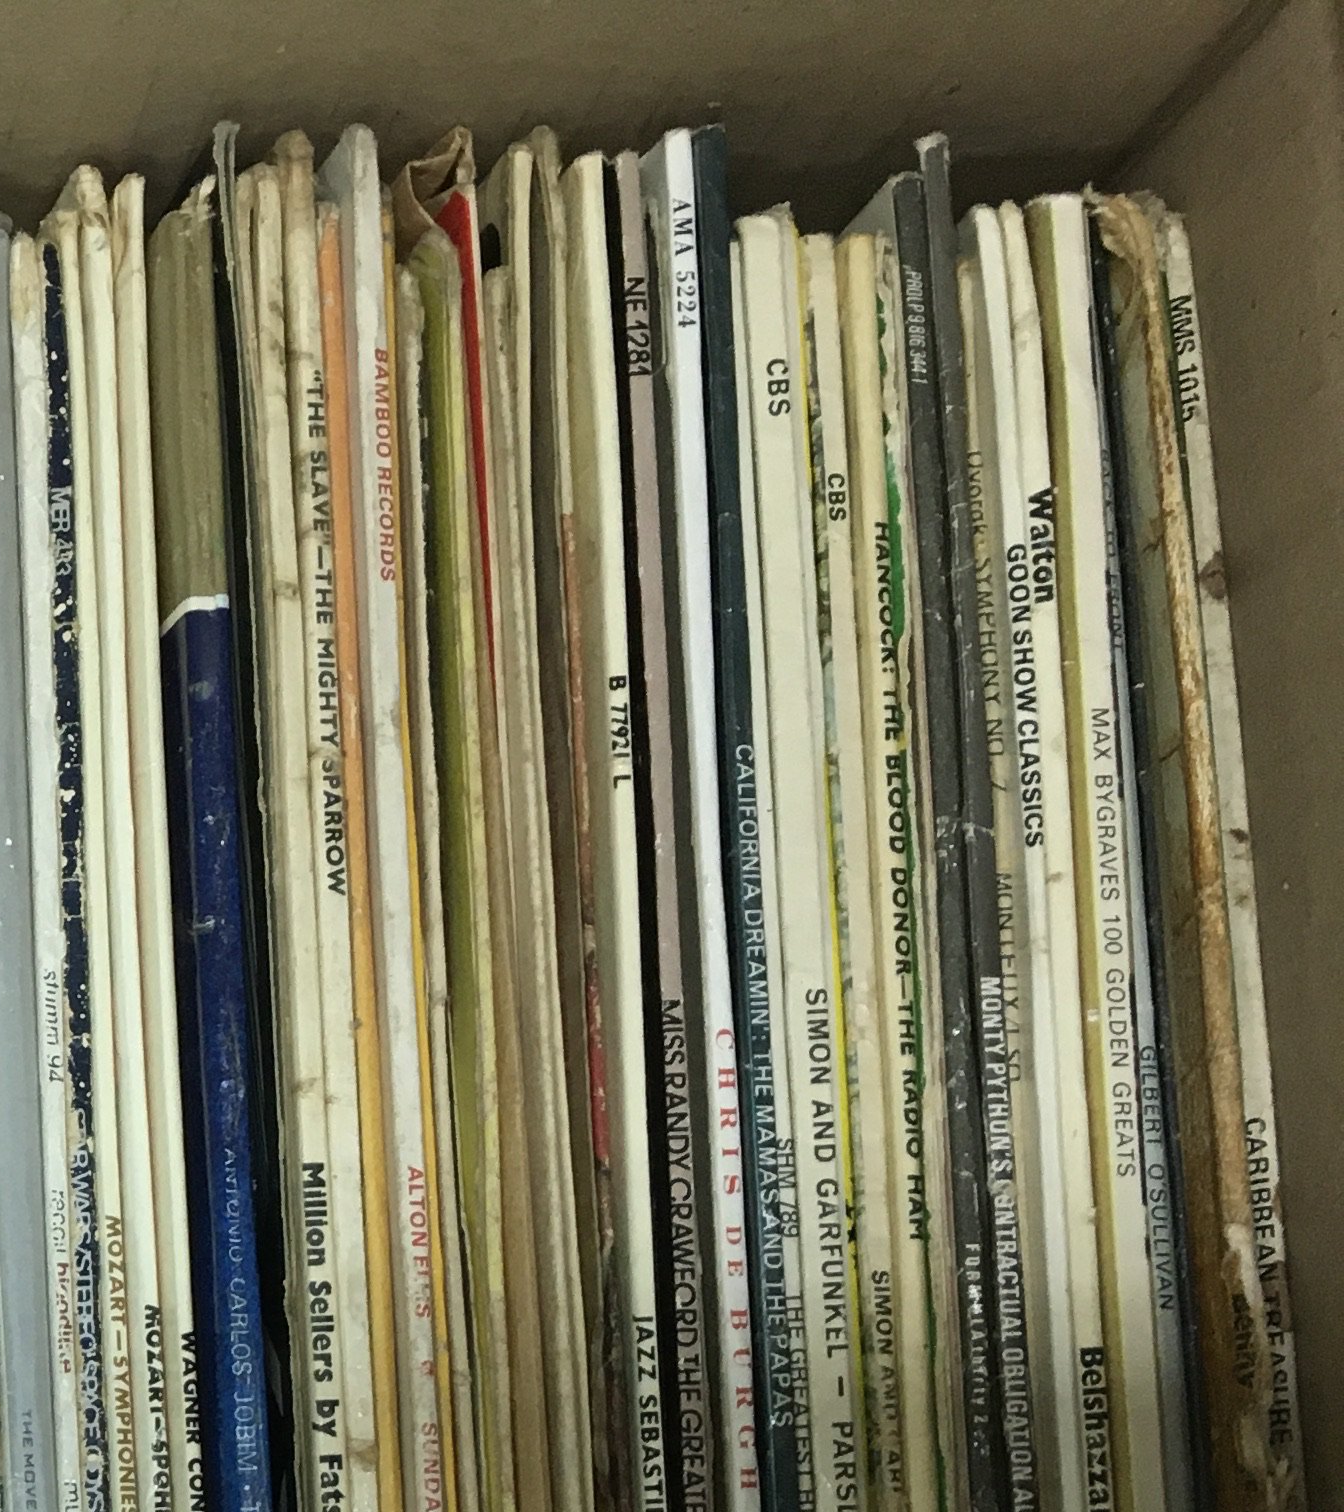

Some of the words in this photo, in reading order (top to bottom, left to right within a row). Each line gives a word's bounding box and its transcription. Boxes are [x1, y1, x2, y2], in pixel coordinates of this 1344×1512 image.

[673, 198, 694, 255] AMA
[625, 277, 647, 313] NE
[676, 270, 696, 328] 5224
[1169, 295, 1195, 355] MMS
[628, 321, 650, 377] 1281
[767, 359, 791, 416] CBS
[374, 349, 392, 459] BAMBOO
[1175, 364, 1200, 422] 1015
[377, 467, 396, 582] RECORDS
[827, 473, 846, 521] CBS
[1006, 544, 1031, 623] GOON
[1028, 488, 1056, 603] Walton
[1012, 629, 1037, 713] SHOW
[1090, 708, 1112, 761] MAX
[736, 744, 761, 899] CALIFORNIA
[1016, 719, 1044, 847] CLASSICS
[1095, 775, 1120, 901] BYGRAVES
[1103, 914, 1122, 955] 100
[743, 908, 770, 1041] DREAMIN':
[806, 988, 830, 1085] SIMON
[1105, 968, 1131, 1067] GOLDEN
[754, 1050, 774, 1096] THE
[757, 1105, 780, 1202] MAMAS
[813, 1100, 834, 1164] AND
[1113, 1082, 1136, 1178] GREATS
[302, 1162, 332, 1266] Million
[761, 1211, 783, 1268] AND
[766, 1278, 787, 1329] THE
[816, 1178, 848, 1359] GARFUNKEL
[309, 1282, 338, 1382] Sellers
[633, 1316, 659, 1382] JAZZ
[312, 1400, 340, 1437] by
[770, 1335, 792, 1427] PAPAS
